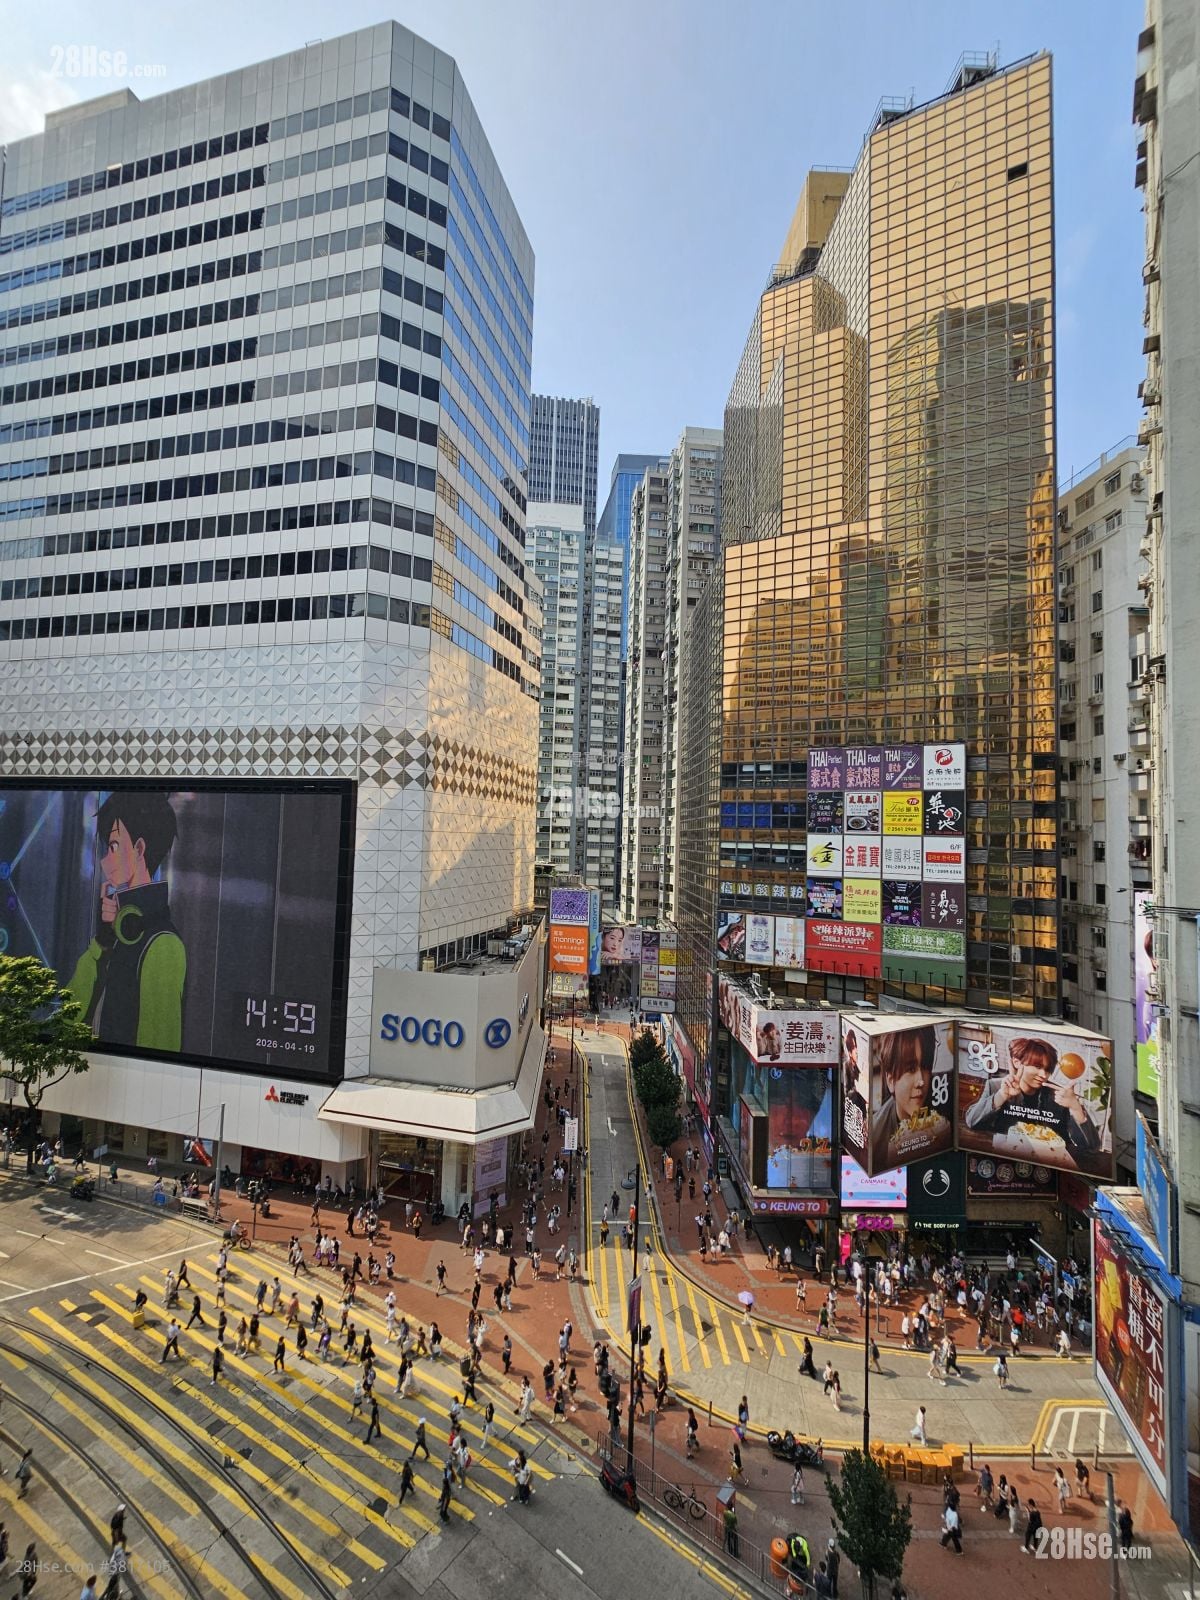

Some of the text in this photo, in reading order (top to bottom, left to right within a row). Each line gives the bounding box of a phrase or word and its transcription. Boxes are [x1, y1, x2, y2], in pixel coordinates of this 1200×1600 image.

[810, 751, 828, 767] THAI
[846, 750, 880, 766] THAI Food
[885, 750, 900, 761] THAI
[846, 767, 880, 788] 泰式料理
[846, 846, 880, 867] 金羅寶
[554, 937, 585, 946] mannings
[246, 998, 316, 1035] 14:59
[380, 1013, 464, 1048] SOGO
[786, 1021, 824, 1040] 姜濤
[784, 1042, 826, 1054] 生日快樂
[968, 1040, 998, 1059] 04
[968, 1055, 998, 1074] 30
[932, 1074, 948, 1091] 04
[932, 1088, 948, 1106] 30
[1004, 1110, 1060, 1124] HAPPY BIRTHDAY
[1010, 1105, 1054, 1118] KEUNG TO
[902, 1138, 920, 1148] KEUNG
[770, 1202, 820, 1212] KEUNG TO
